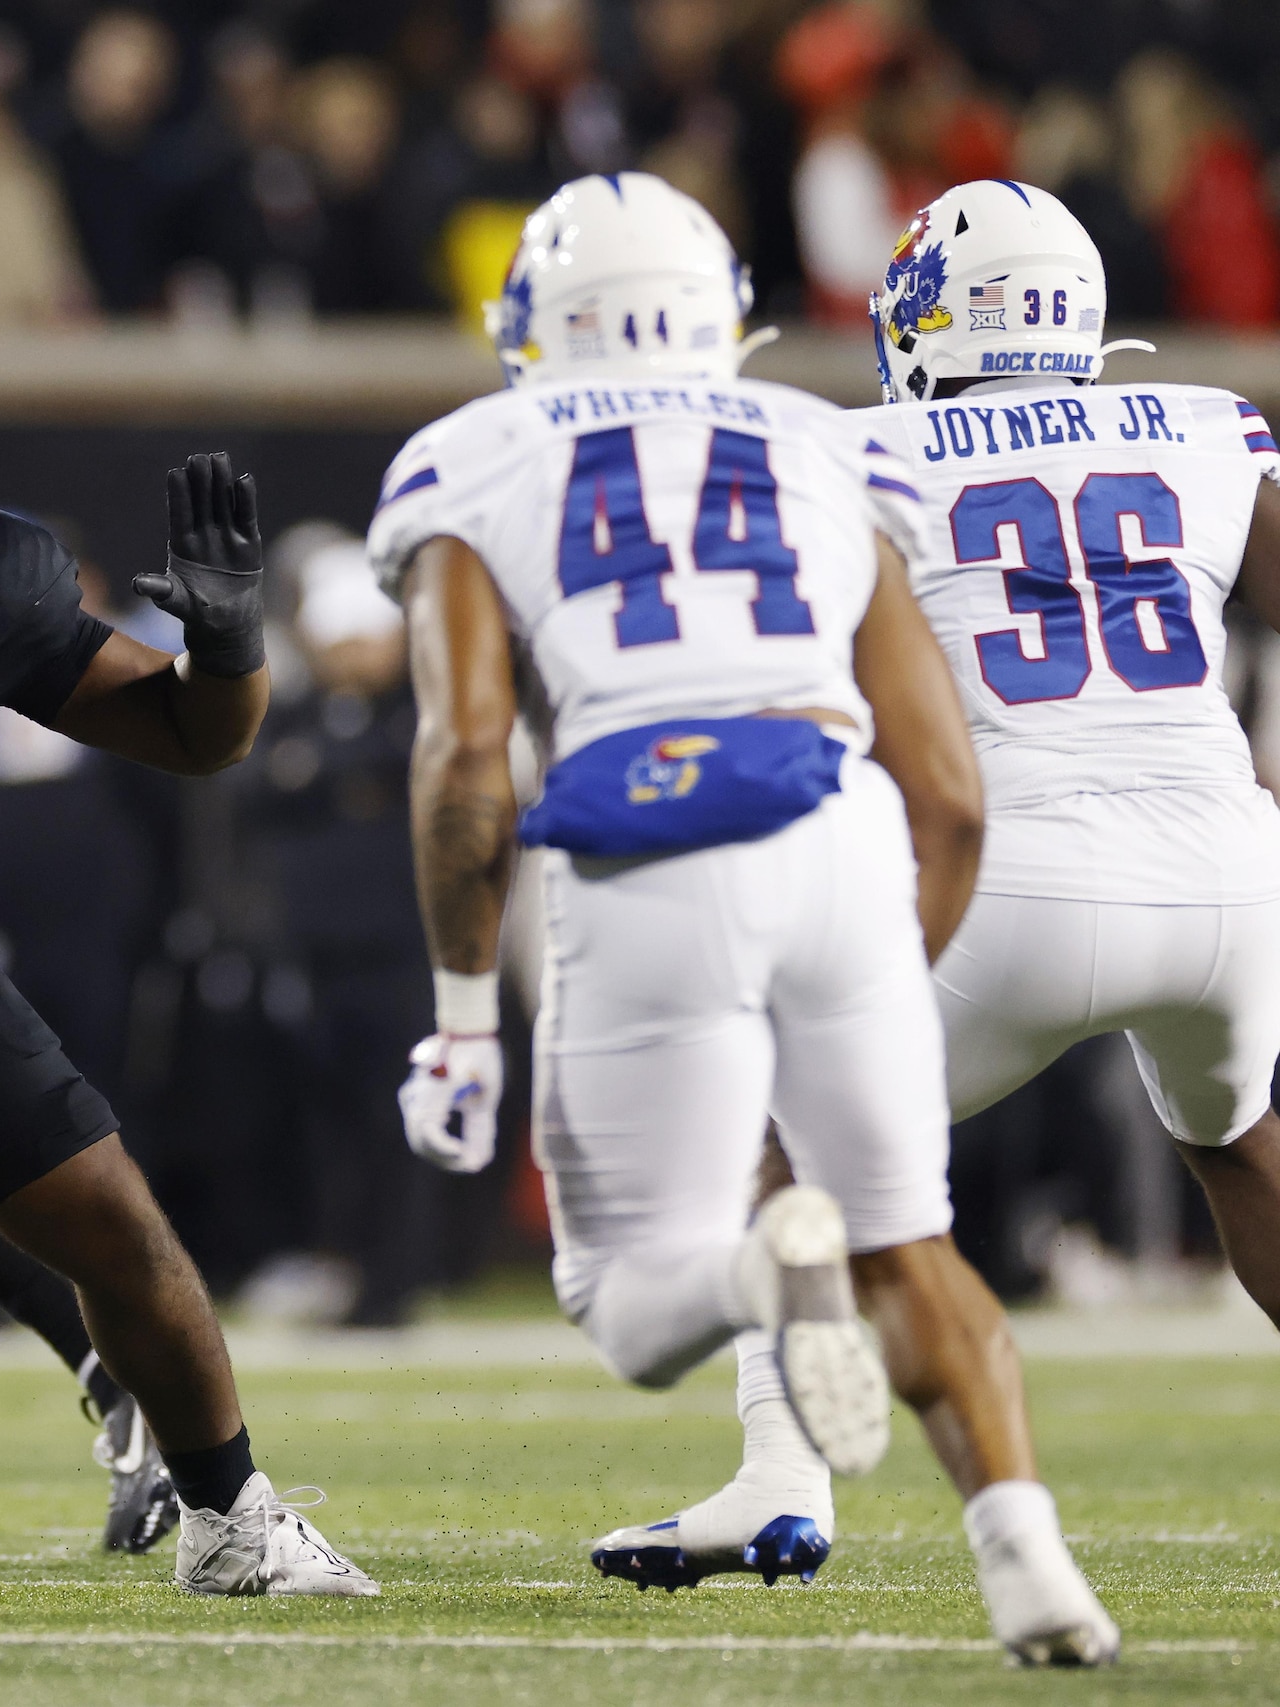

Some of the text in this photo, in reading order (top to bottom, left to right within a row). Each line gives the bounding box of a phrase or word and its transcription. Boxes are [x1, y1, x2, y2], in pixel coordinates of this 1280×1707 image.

[981, 352, 1094, 374] ROCK CHALK
[536, 389, 770, 426] WHEELER
[924, 394, 1185, 462] JOYNER JR.
[557, 426, 817, 650] 44
[949, 472, 1209, 706] 36
